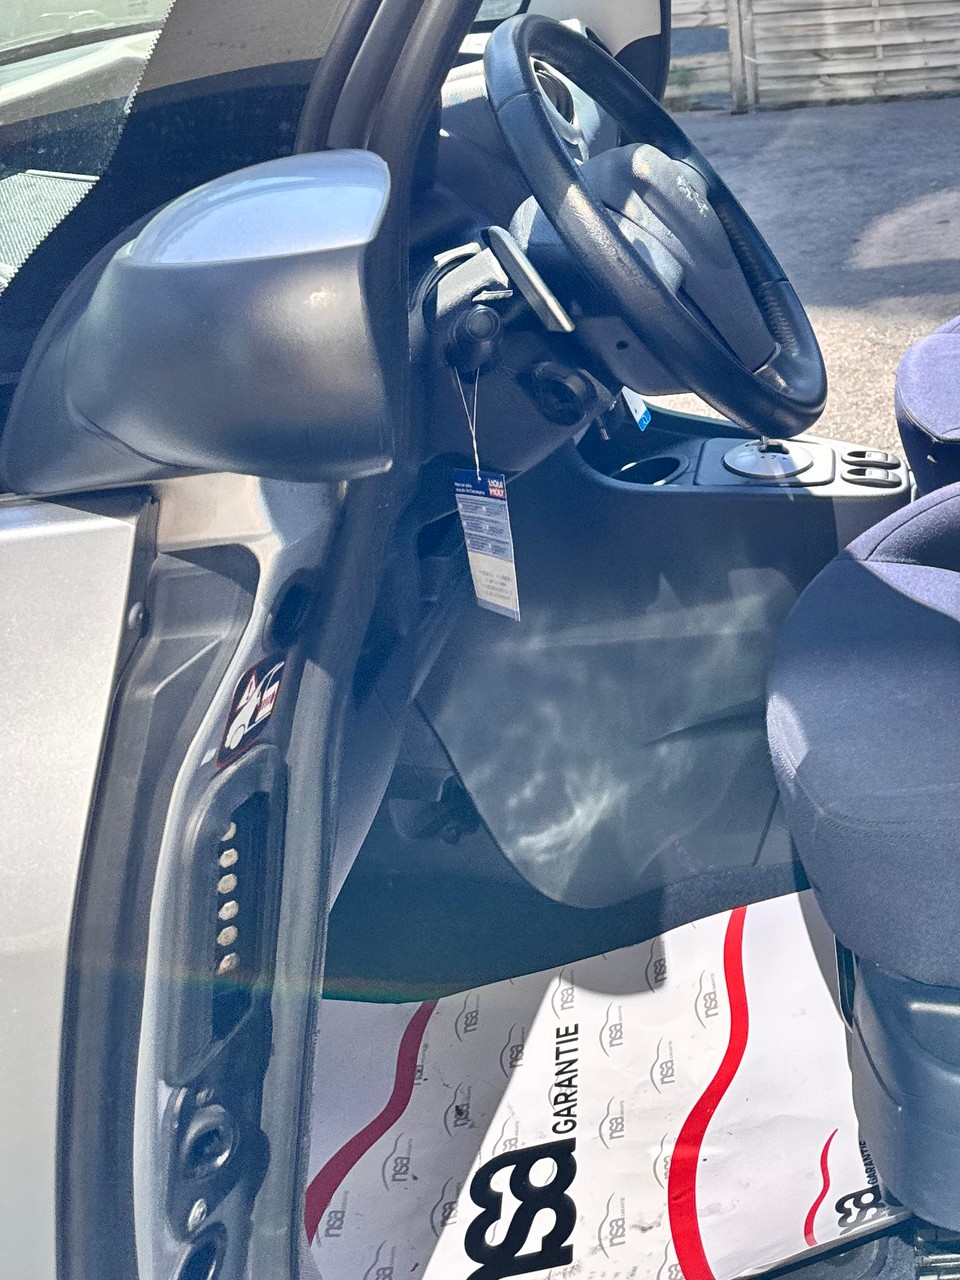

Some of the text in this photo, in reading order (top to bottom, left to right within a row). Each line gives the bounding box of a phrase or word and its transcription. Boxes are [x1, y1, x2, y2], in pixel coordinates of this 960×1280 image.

[560, 987, 575, 1010] nsa
[704, 991, 719, 1019] nsa
[464, 1009, 479, 1034] nsa
[609, 1023, 623, 1048] nsa
[508, 1043, 525, 1069] nsa
[551, 1023, 579, 1135] GARANTIE
[660, 1058, 675, 1085] nsa
[608, 1115, 625, 1140] nsa
[392, 1156, 411, 1183] nsa
[859, 1140, 879, 1185] GARANTIE
[324, 1209, 346, 1238] nsa
[608, 1217, 626, 1248] nsa
